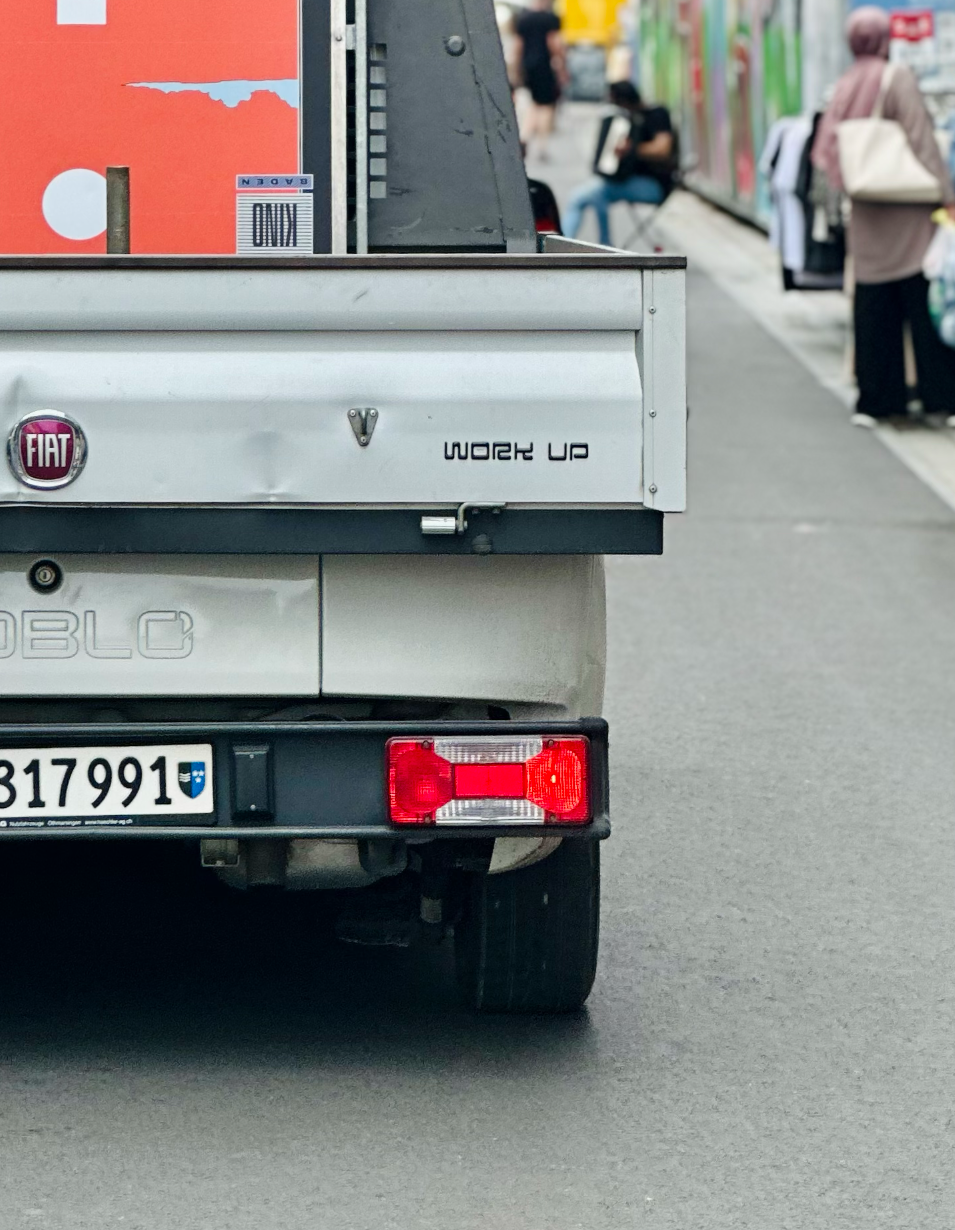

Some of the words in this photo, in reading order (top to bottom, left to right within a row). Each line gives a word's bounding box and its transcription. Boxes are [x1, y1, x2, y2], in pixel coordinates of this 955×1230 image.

[252, 203, 297, 247] KINO
[26, 433, 71, 467] FIAT
[444, 441, 534, 460] WORK
[548, 442, 589, 461] UP
